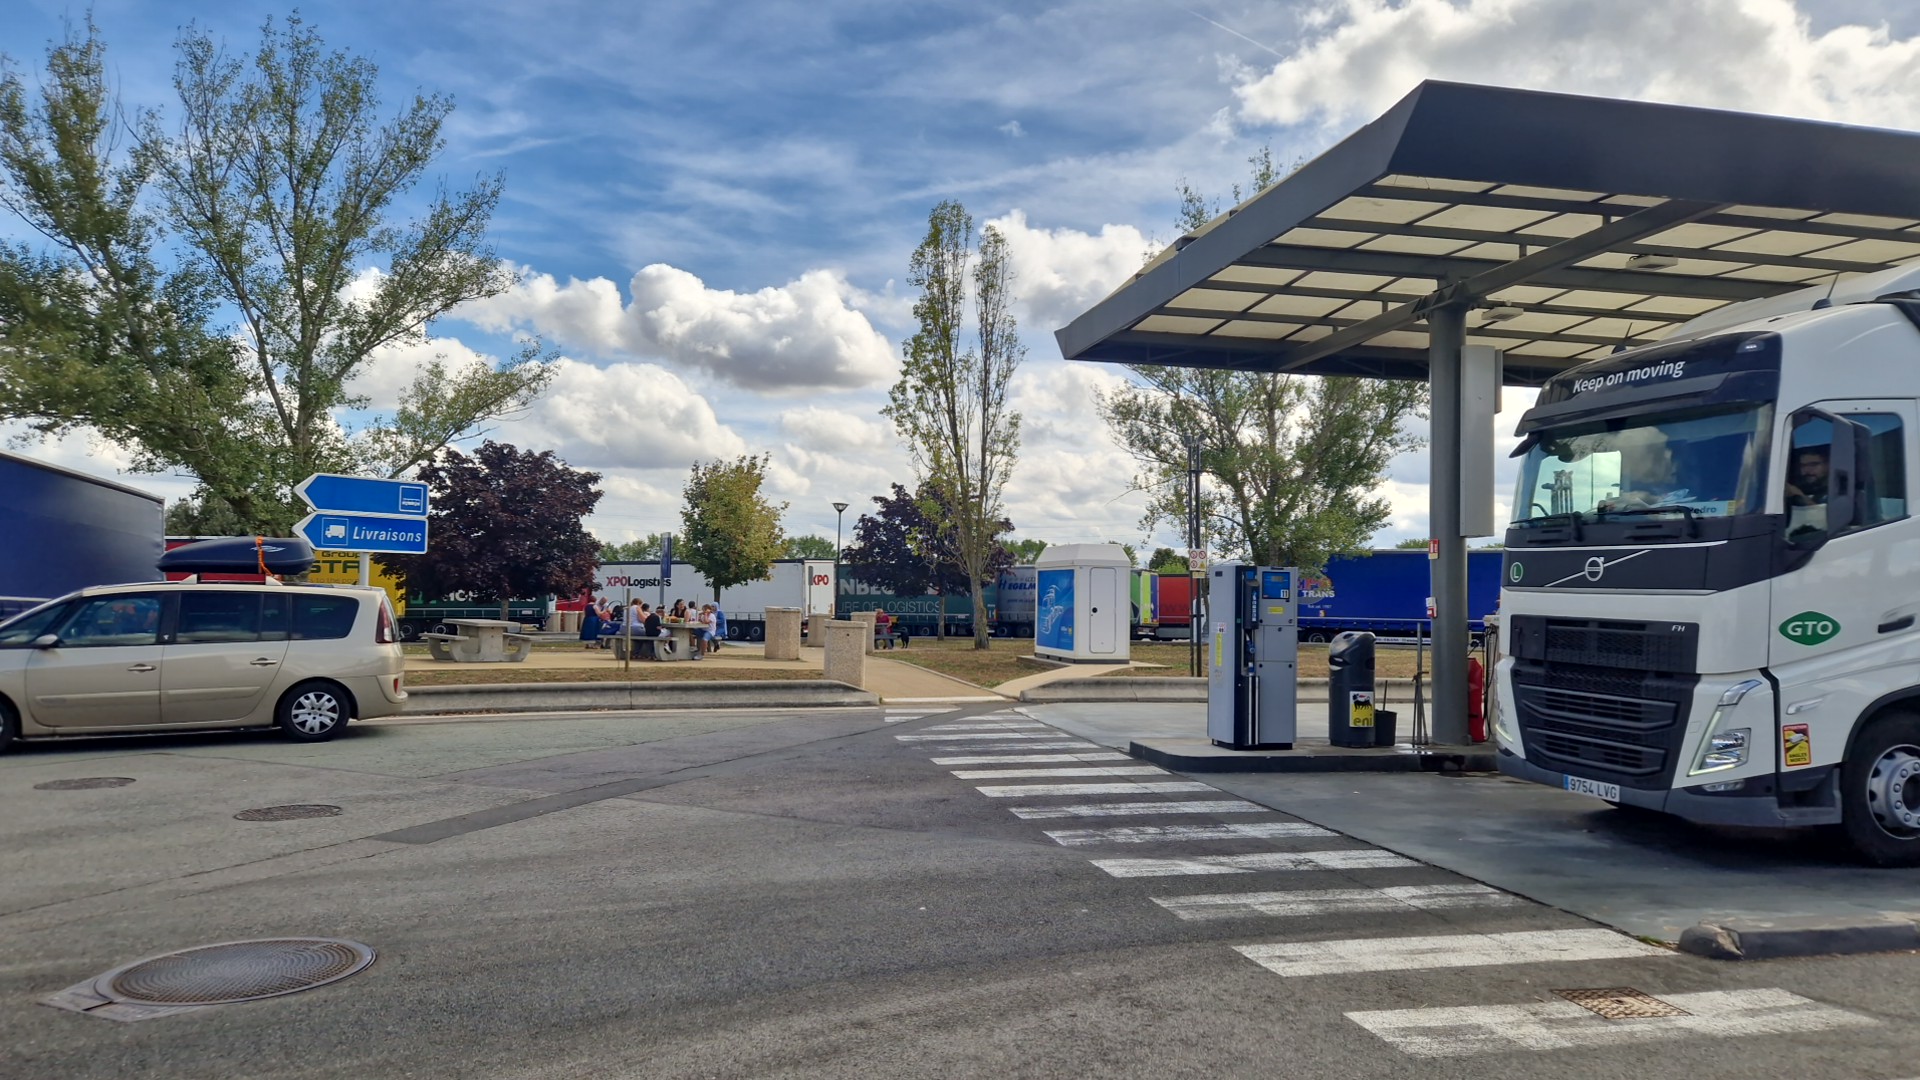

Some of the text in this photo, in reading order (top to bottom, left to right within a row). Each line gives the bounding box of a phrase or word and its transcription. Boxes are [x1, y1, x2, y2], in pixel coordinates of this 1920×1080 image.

[1572, 360, 1686, 394] Keep on moving
[352, 526, 422, 542] Livraisons
[1787, 621, 1833, 636] GTO
[1353, 713, 1373, 727] eni
[1570, 778, 1617, 799] 9754 LVG
